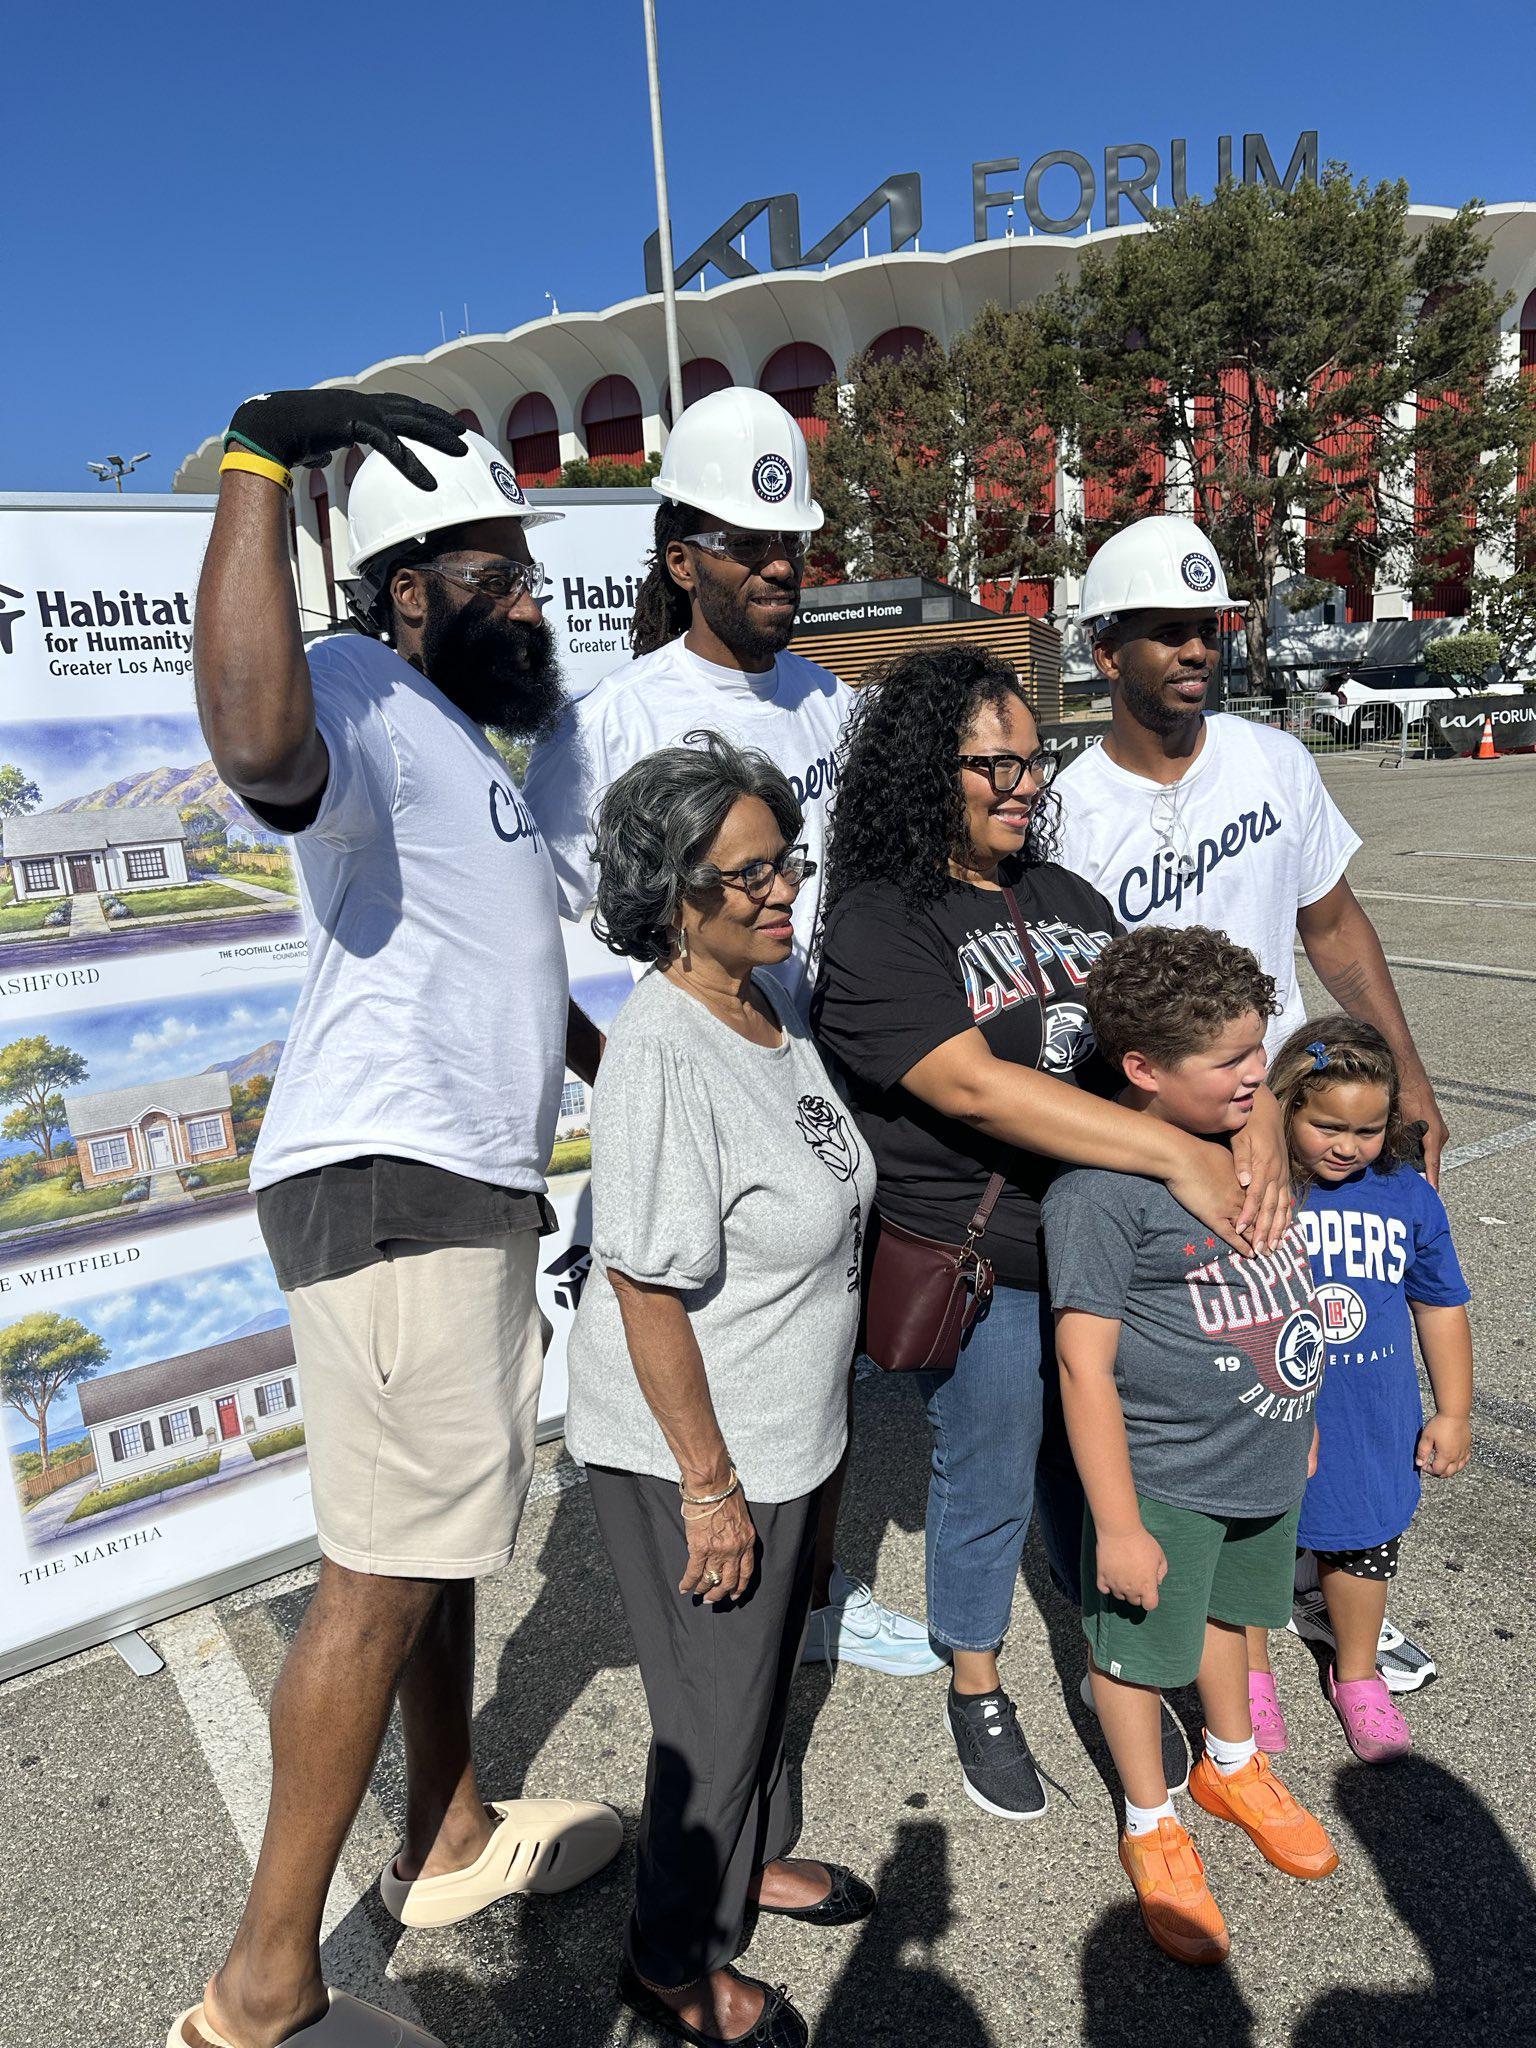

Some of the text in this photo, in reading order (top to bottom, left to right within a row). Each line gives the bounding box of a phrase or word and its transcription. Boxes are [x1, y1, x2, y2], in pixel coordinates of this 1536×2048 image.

[972, 131, 1318, 241] FORUM
[563, 575, 643, 610] Habit
[37, 590, 193, 627] Habitat
[802, 606, 865, 624] Connected
[867, 605, 903, 618] Home
[567, 615, 591, 633] for
[45, 630, 193, 654] for Humanity
[569, 638, 617, 653] Greater
[50, 657, 193, 676] Greater Los Ange
[1118, 801, 1281, 922] Clippers
[218, 950, 233, 959] THE
[234, 945, 273, 957] FOOTHILL
[273, 950, 308, 960] FOUNDATIO
[1298, 1210, 1407, 1284] PPERS
[19, 1247, 141, 1287] WHITFIELD
[1213, 1357, 1241, 1372] 19
[1329, 1343, 1395, 1366] ETBALL
[1239, 1378, 1321, 1422] BASKET
[19, 1526, 163, 1587] THE MARTHA
